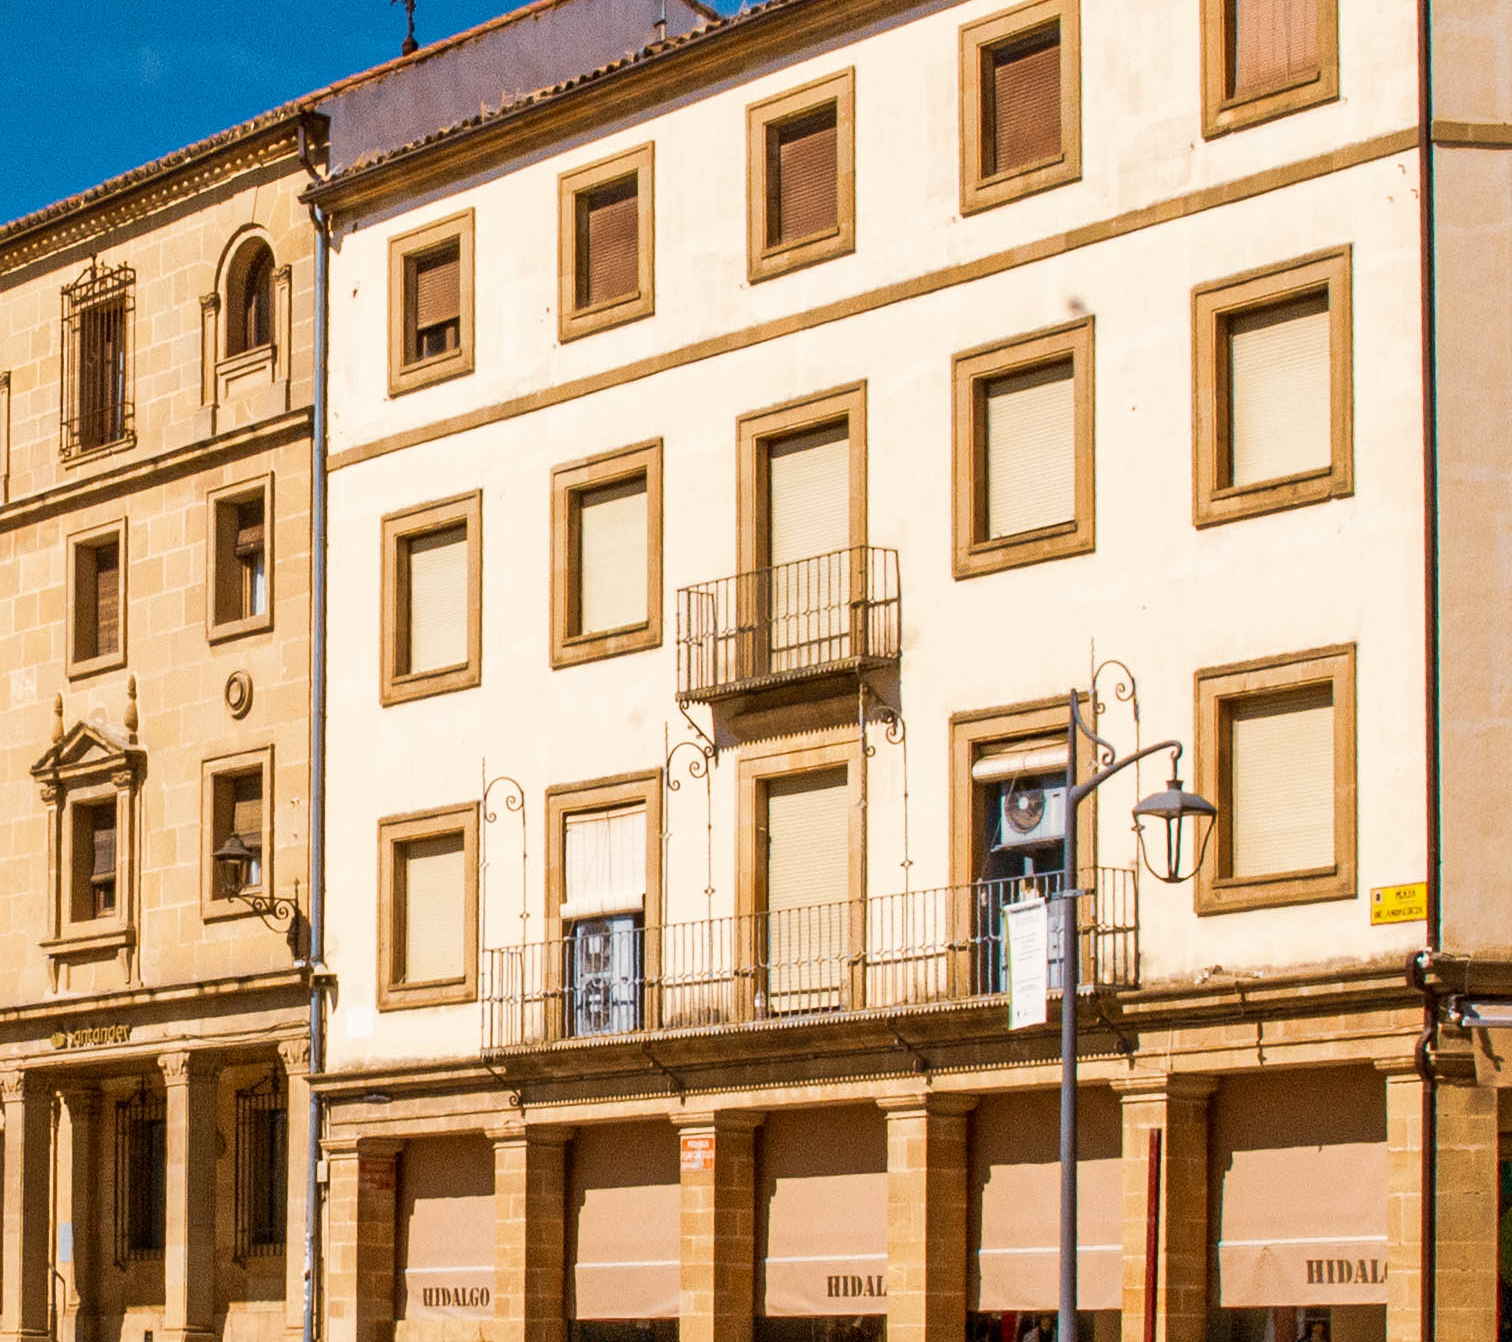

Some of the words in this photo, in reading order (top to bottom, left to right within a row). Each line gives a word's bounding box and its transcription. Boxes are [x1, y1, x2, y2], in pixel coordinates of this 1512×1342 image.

[1306, 1259, 1388, 1284] HIDAL
[423, 1287, 490, 1307] HIDALGO
[827, 1275, 888, 1297] HIDAL
